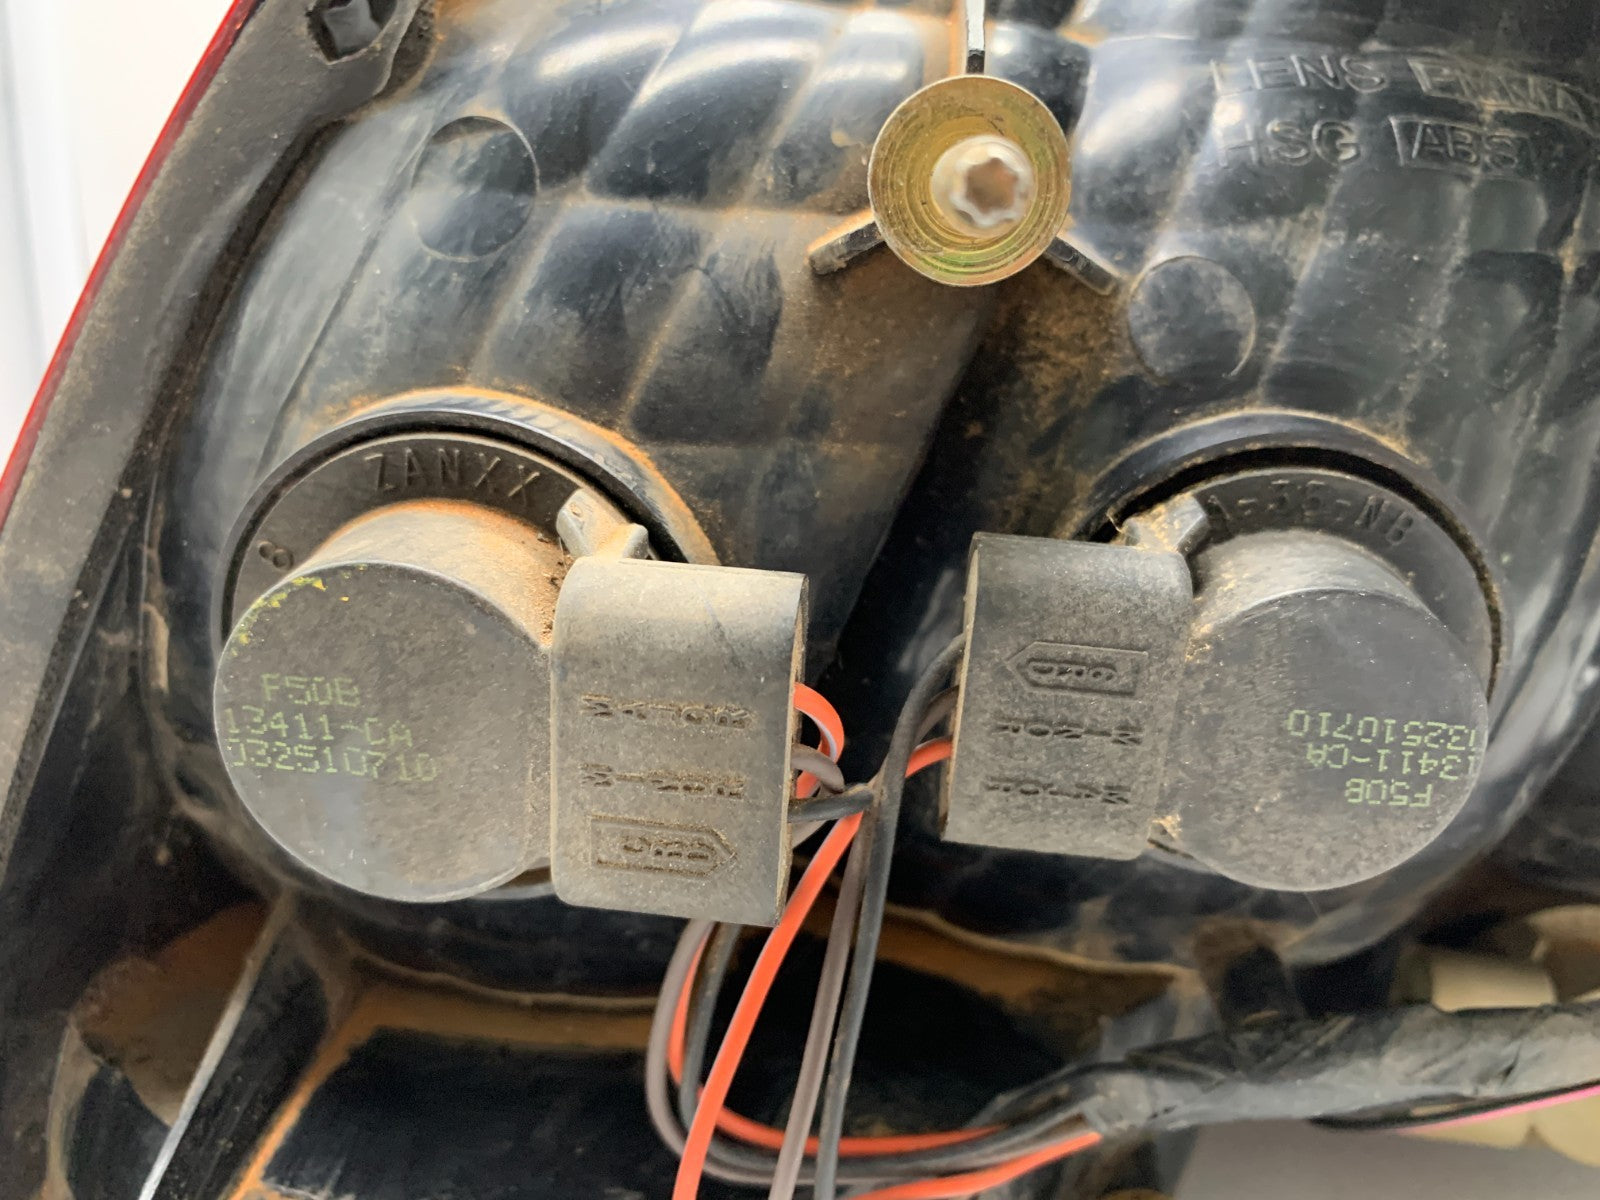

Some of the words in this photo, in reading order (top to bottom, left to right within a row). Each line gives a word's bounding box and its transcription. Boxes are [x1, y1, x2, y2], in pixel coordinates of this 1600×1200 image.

[1209, 54, 1389, 97] LENS
[1214, 118, 1363, 167] HSG
[1410, 121, 1520, 169] ABS
[364, 447, 541, 504] ZANXX
